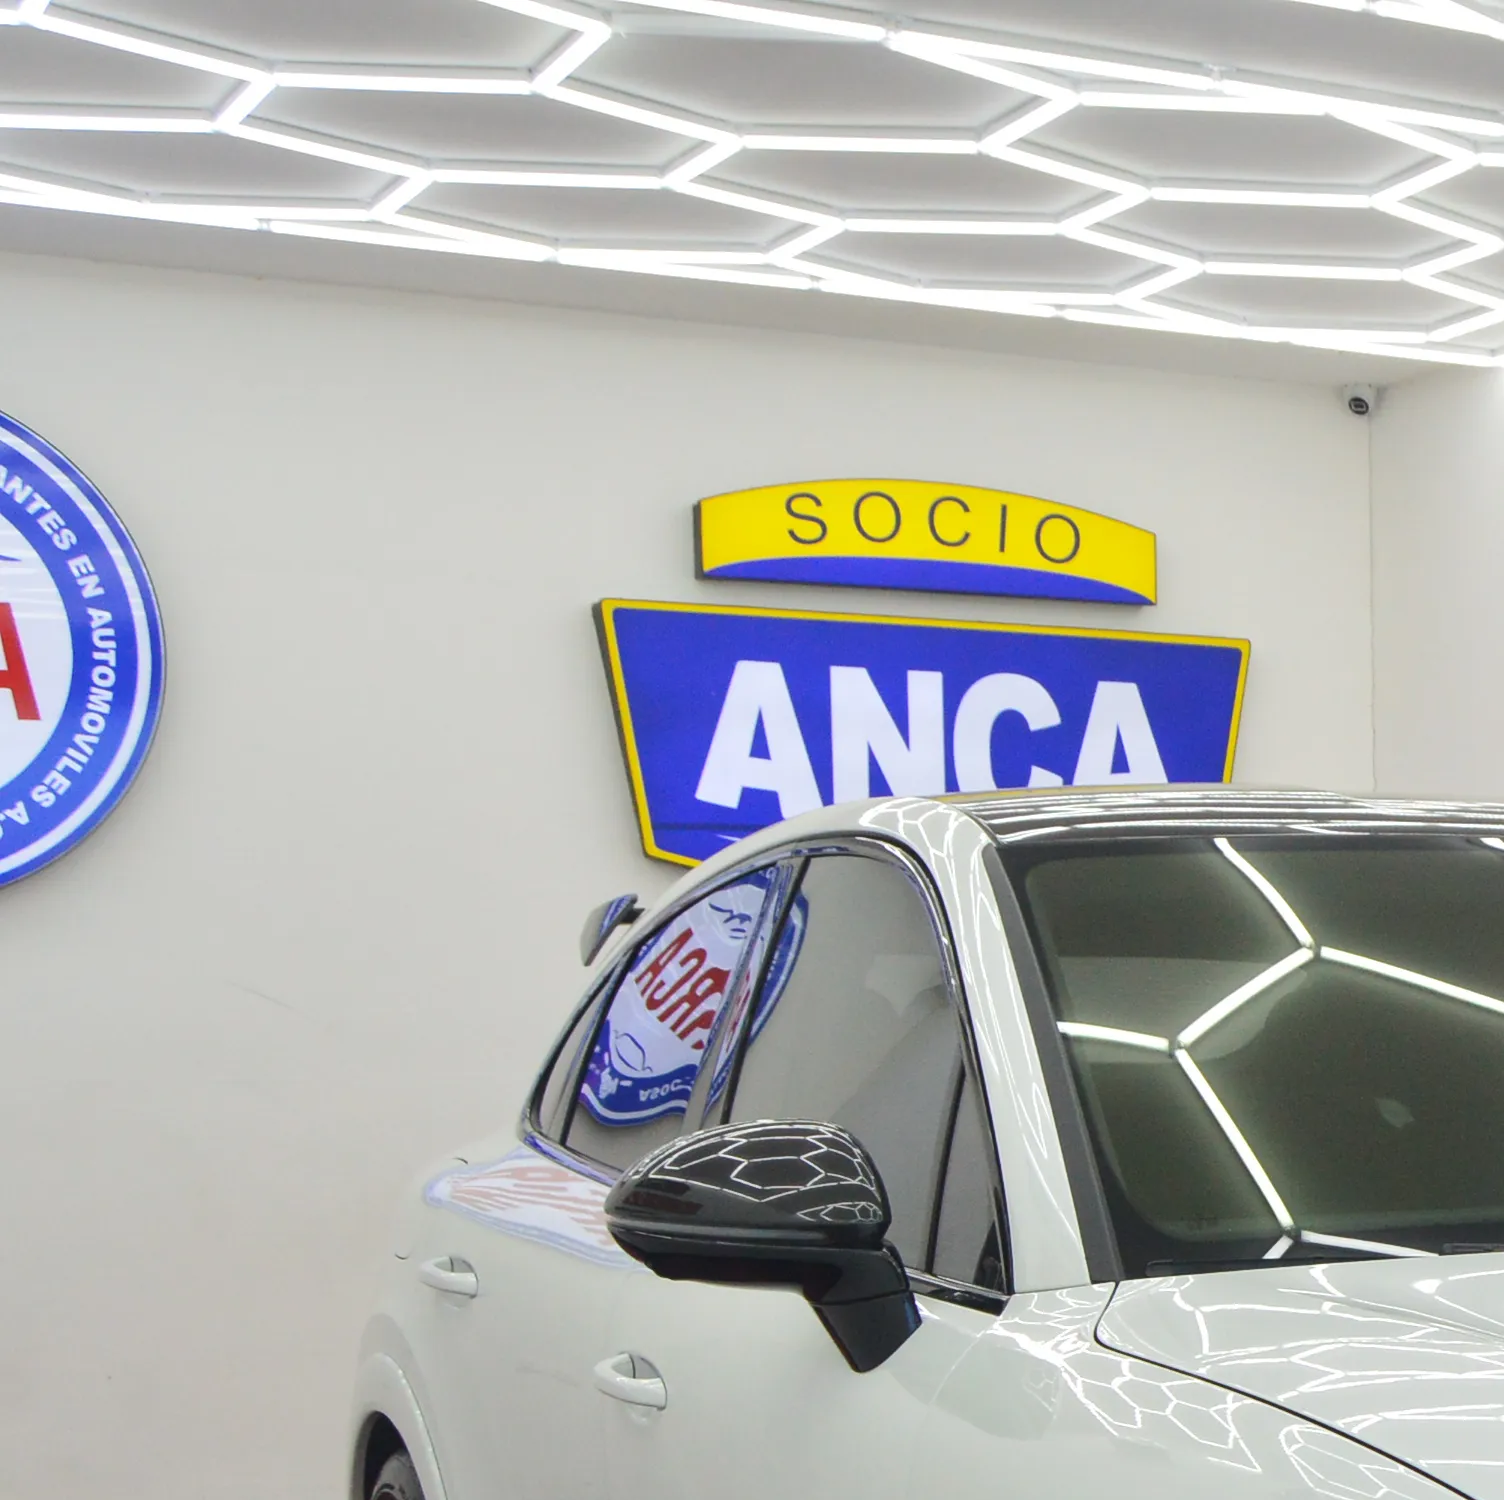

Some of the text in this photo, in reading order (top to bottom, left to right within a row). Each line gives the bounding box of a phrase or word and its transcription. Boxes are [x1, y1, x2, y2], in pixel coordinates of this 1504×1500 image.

[68, 554, 104, 598] EN
[784, 491, 1081, 564] SOCIO
[31, 607, 117, 808] AUTOMOVILES
[695, 660, 1169, 821] ANCA
